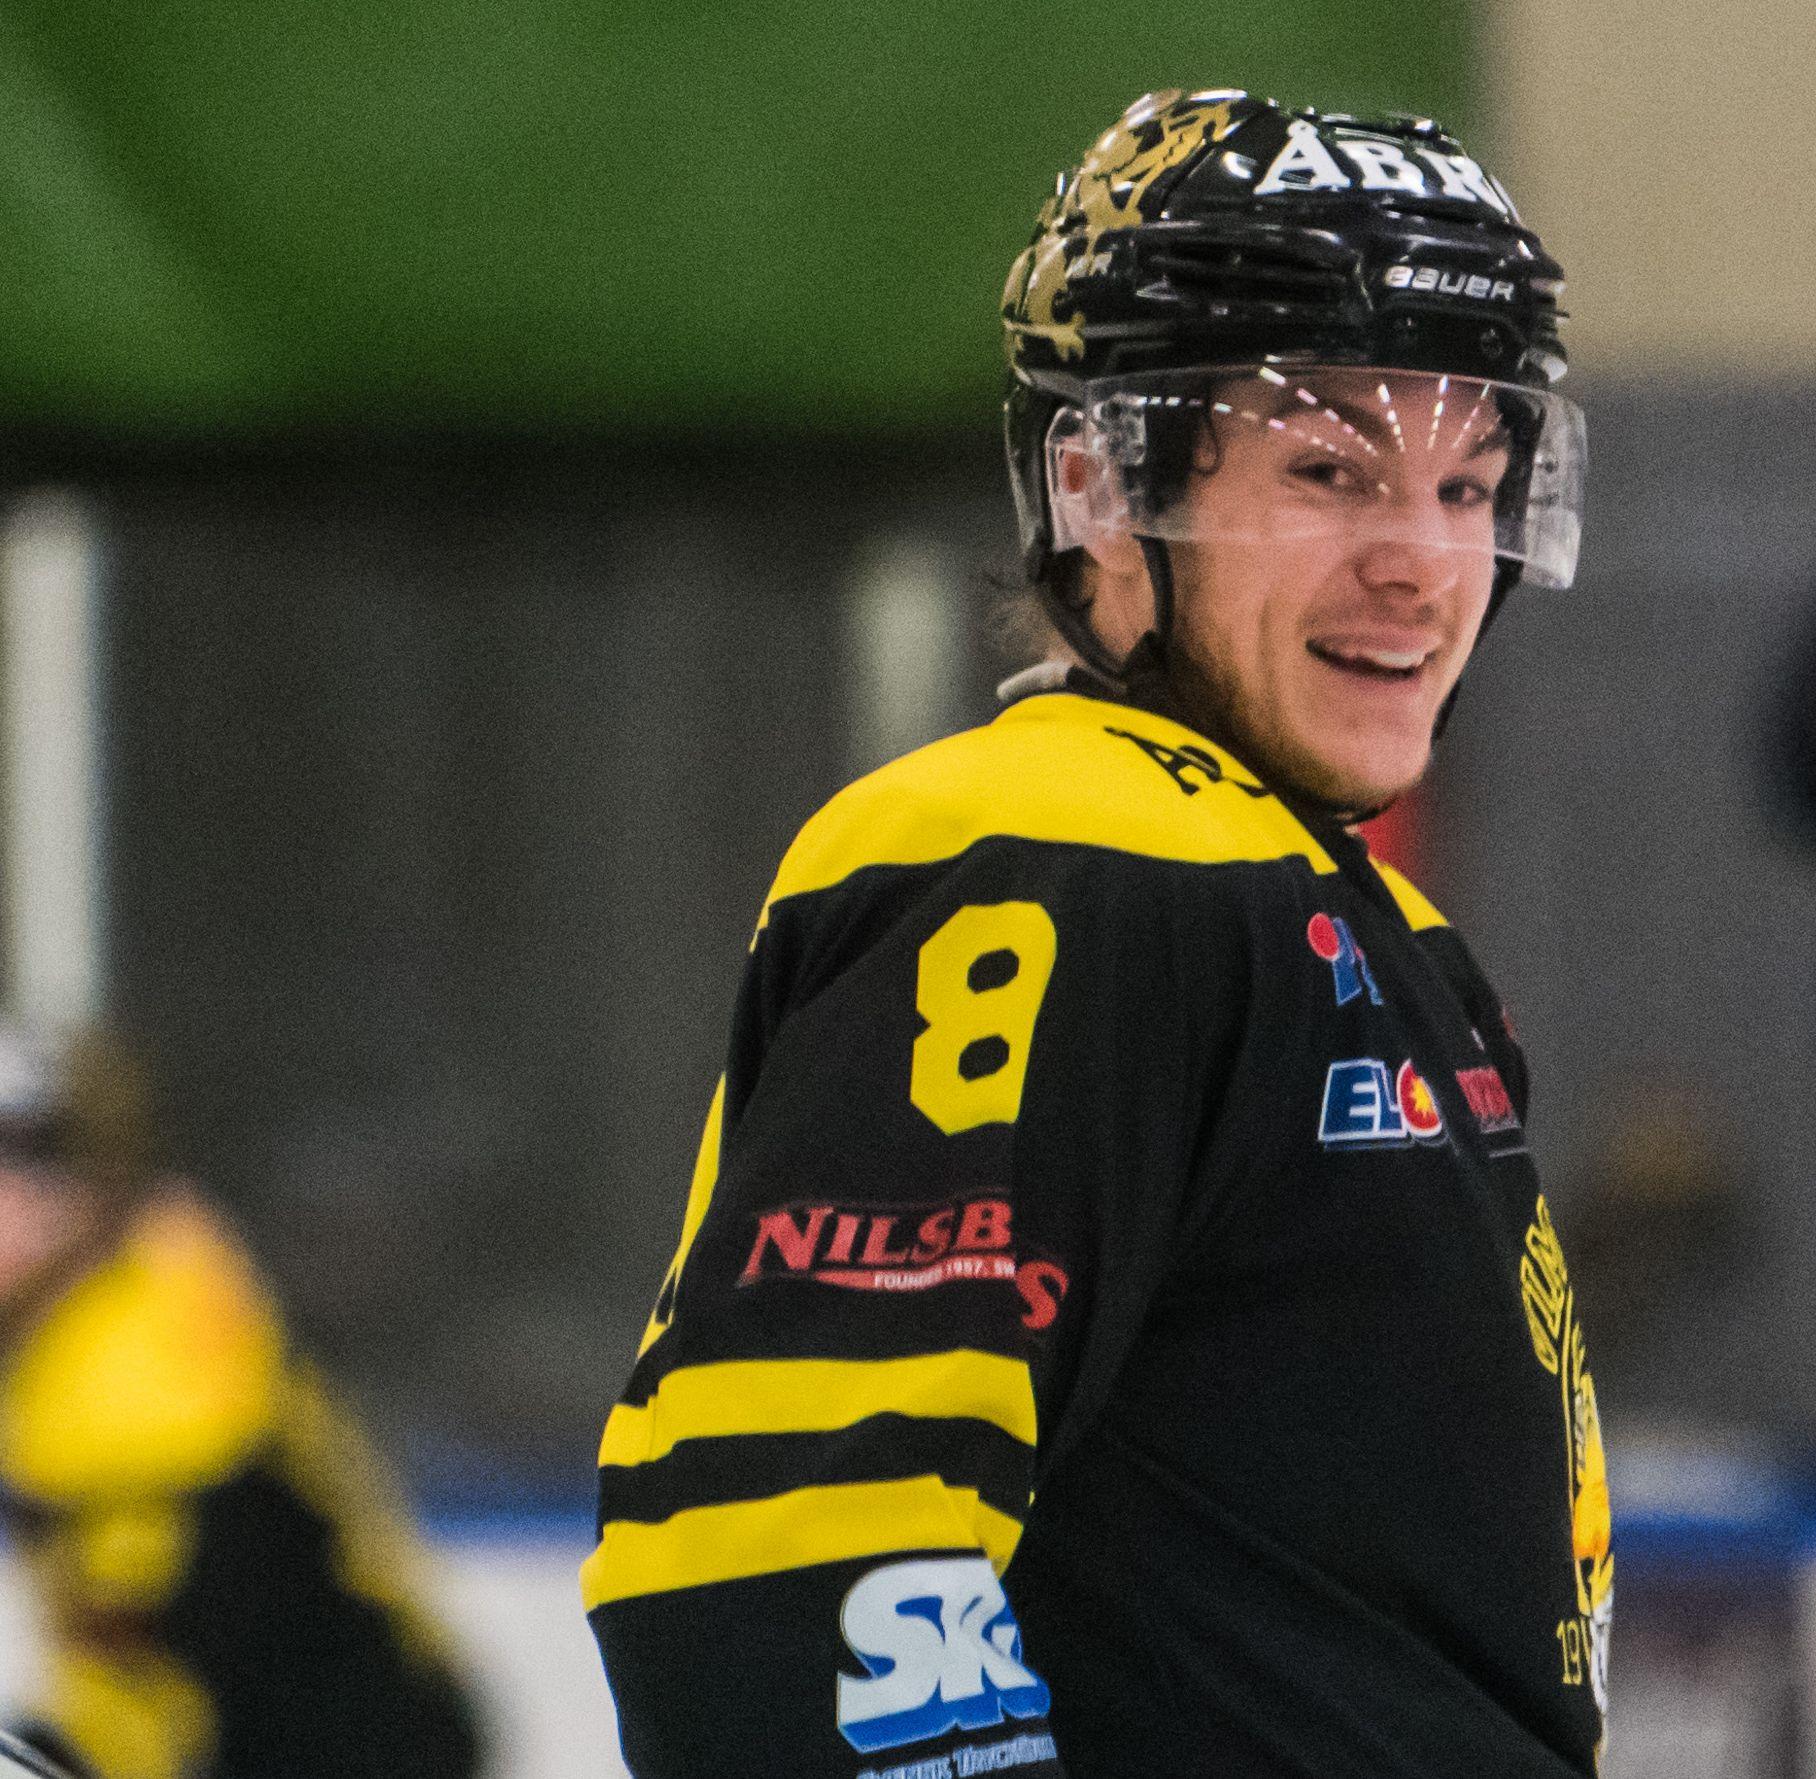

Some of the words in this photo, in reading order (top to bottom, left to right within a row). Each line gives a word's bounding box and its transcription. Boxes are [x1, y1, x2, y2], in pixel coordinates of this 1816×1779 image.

[1253, 119, 1510, 217] ÅBR
[1385, 264, 1515, 301] BAUER
[910, 900, 1058, 1136] 8
